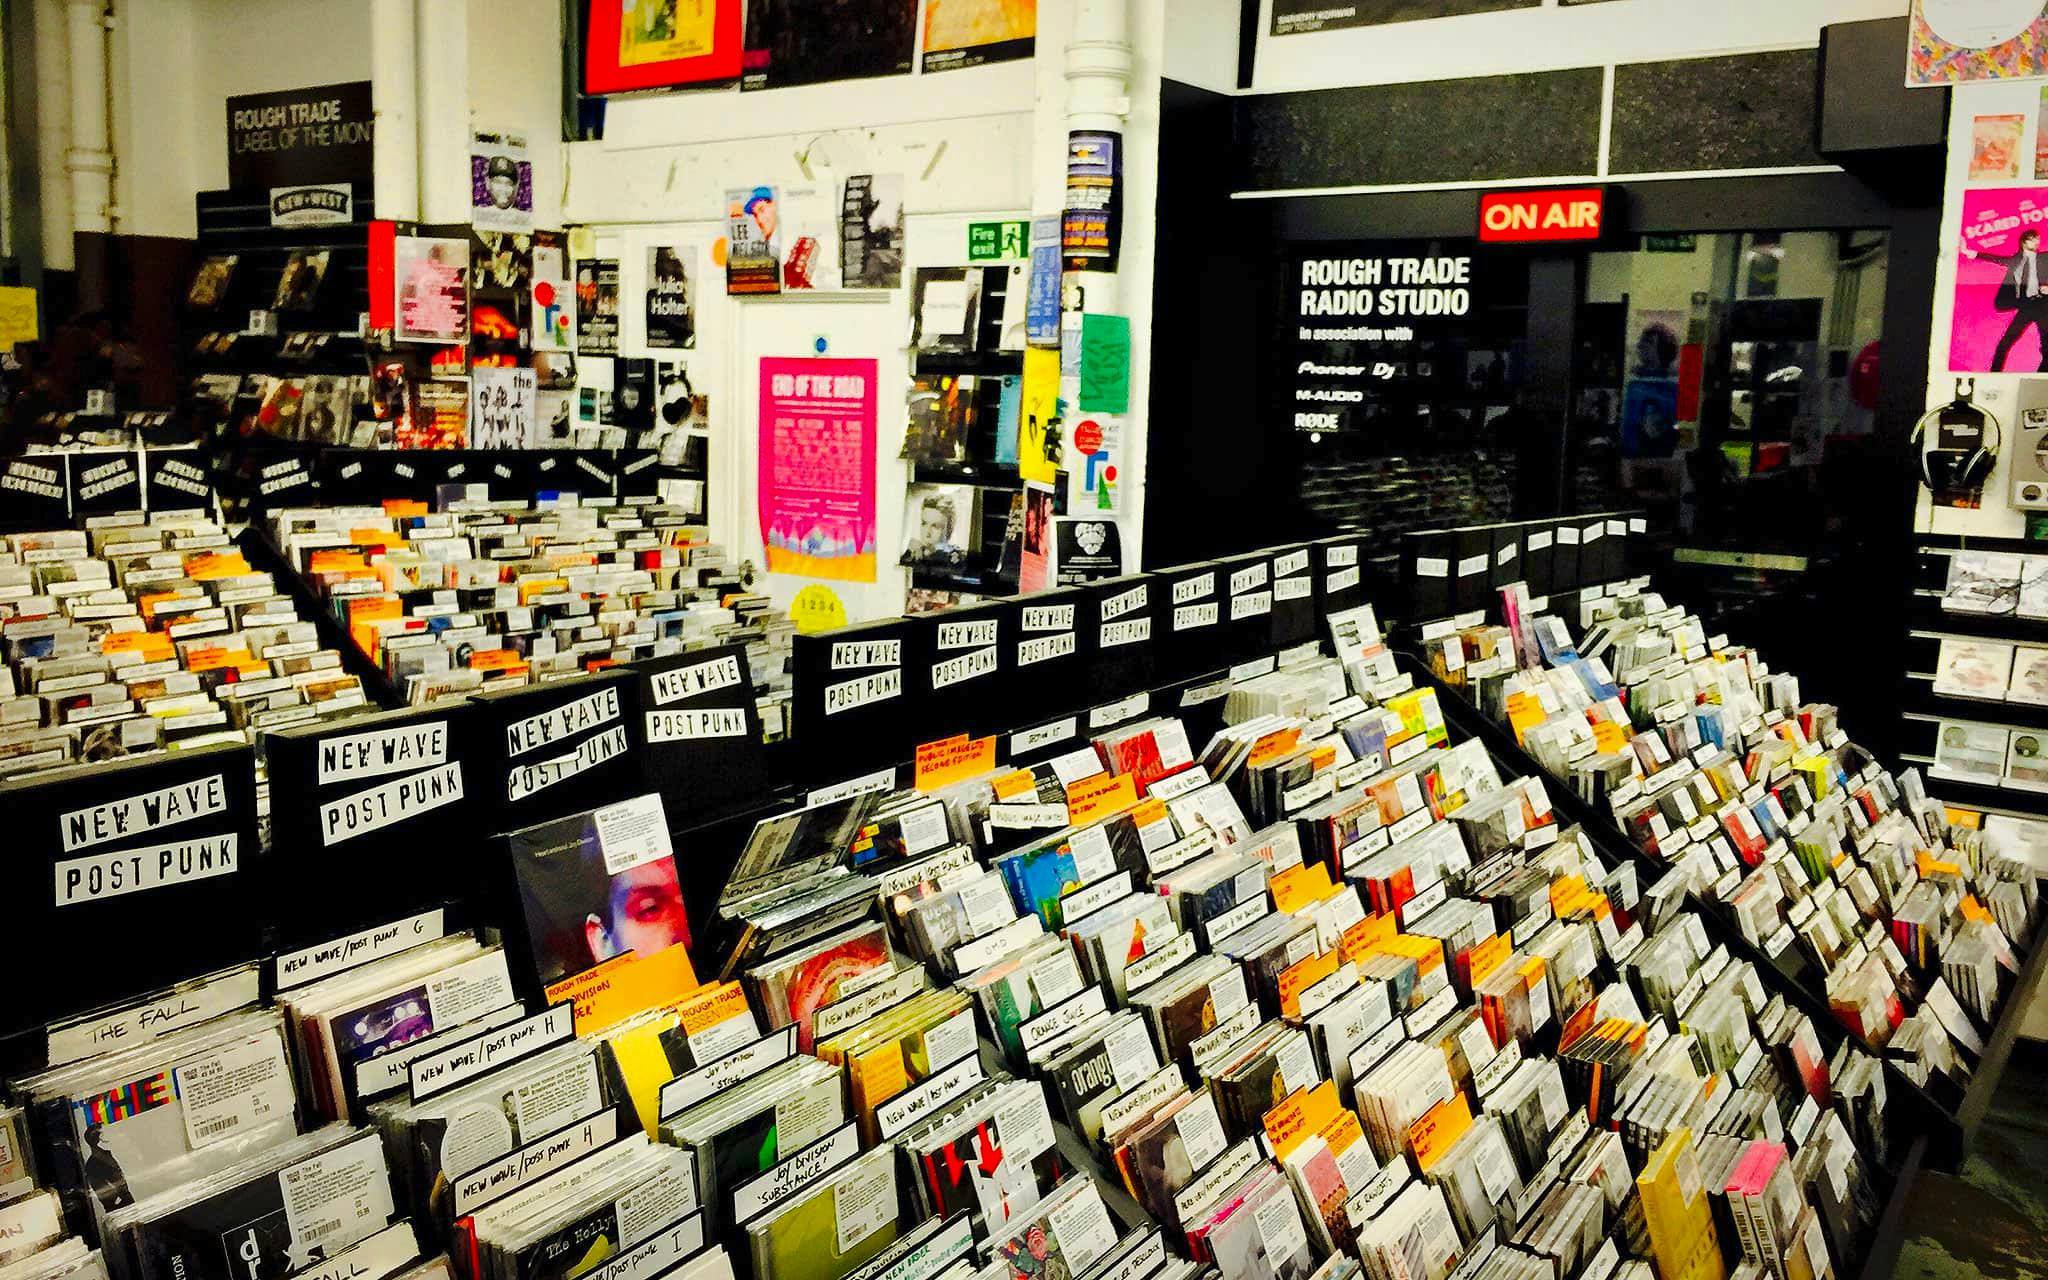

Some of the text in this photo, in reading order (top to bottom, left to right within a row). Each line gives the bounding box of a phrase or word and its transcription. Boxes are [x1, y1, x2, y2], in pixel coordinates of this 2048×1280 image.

[234, 100, 341, 130] ROUGH TRADE
[279, 127, 298, 149] OF
[304, 124, 330, 146] THE
[1485, 200, 1600, 231] ON AIR
[1965, 216, 2020, 239] SCARED
[972, 228, 995, 240] Fire
[972, 244, 995, 256] exit
[656, 277, 685, 295] Julia
[1302, 257, 1471, 286] ROUGH TRADE
[650, 298, 690, 316] Holter
[1300, 288, 1470, 316] RADIO STUDIO
[1313, 327, 1382, 341] association
[1384, 327, 1413, 341] with
[1298, 361, 1366, 376] Pioneer
[1295, 389, 1364, 402] M-AUDIO
[1103, 585, 1147, 617] NEW WAVE
[1175, 573, 1215, 600] NEW WAVE
[1023, 606, 1073, 627] NEW WAVE
[1102, 619, 1150, 643] POST PUNK
[1175, 605, 1219, 628] POST PUNK
[940, 623, 995, 646] NEW WAVE
[1020, 633, 1074, 664] POST PUNK
[834, 643, 898, 666] NEW WAVE
[935, 651, 996, 685] POST PUNK
[658, 660, 738, 697] NEW WAVE
[829, 673, 900, 709] POST PUNK
[509, 689, 618, 756] NEW WAVE
[653, 711, 744, 736] POST PUNK
[323, 728, 443, 773] NEW WAVE
[70, 778, 221, 845] NEW WAVE
[328, 770, 459, 837] POST PUNK
[67, 840, 231, 899] POST PUNK
[285, 954, 308, 974] NEW
[373, 927, 399, 949] PUNK
[413, 919, 425, 934] G
[548, 970, 600, 999] ROUGH TRADE
[682, 986, 744, 1019] ROUGH TRADE
[686, 1003, 742, 1032] ESSENTIAL
[85, 999, 200, 1044] THE FALL
[824, 1010, 843, 1026] NEW
[1030, 1004, 1086, 1041] ORANGE JUICE
[420, 1064, 444, 1083] NEW
[509, 1025, 536, 1048] PUNK
[544, 1015, 555, 1035] H
[83, 1070, 171, 1127] THE
[886, 1065, 978, 1127] NEW PUNK L
[463, 1180, 487, 1198] NEW
[548, 1138, 571, 1162] PUNK
[583, 1125, 593, 1145] H
[774, 1138, 836, 1184] JOY DIVISION
[547, 1238, 570, 1258] The
[631, 1230, 682, 1270] PUNK I
[885, 1260, 905, 1280] NEW
[907, 1244, 929, 1268] ORDER
